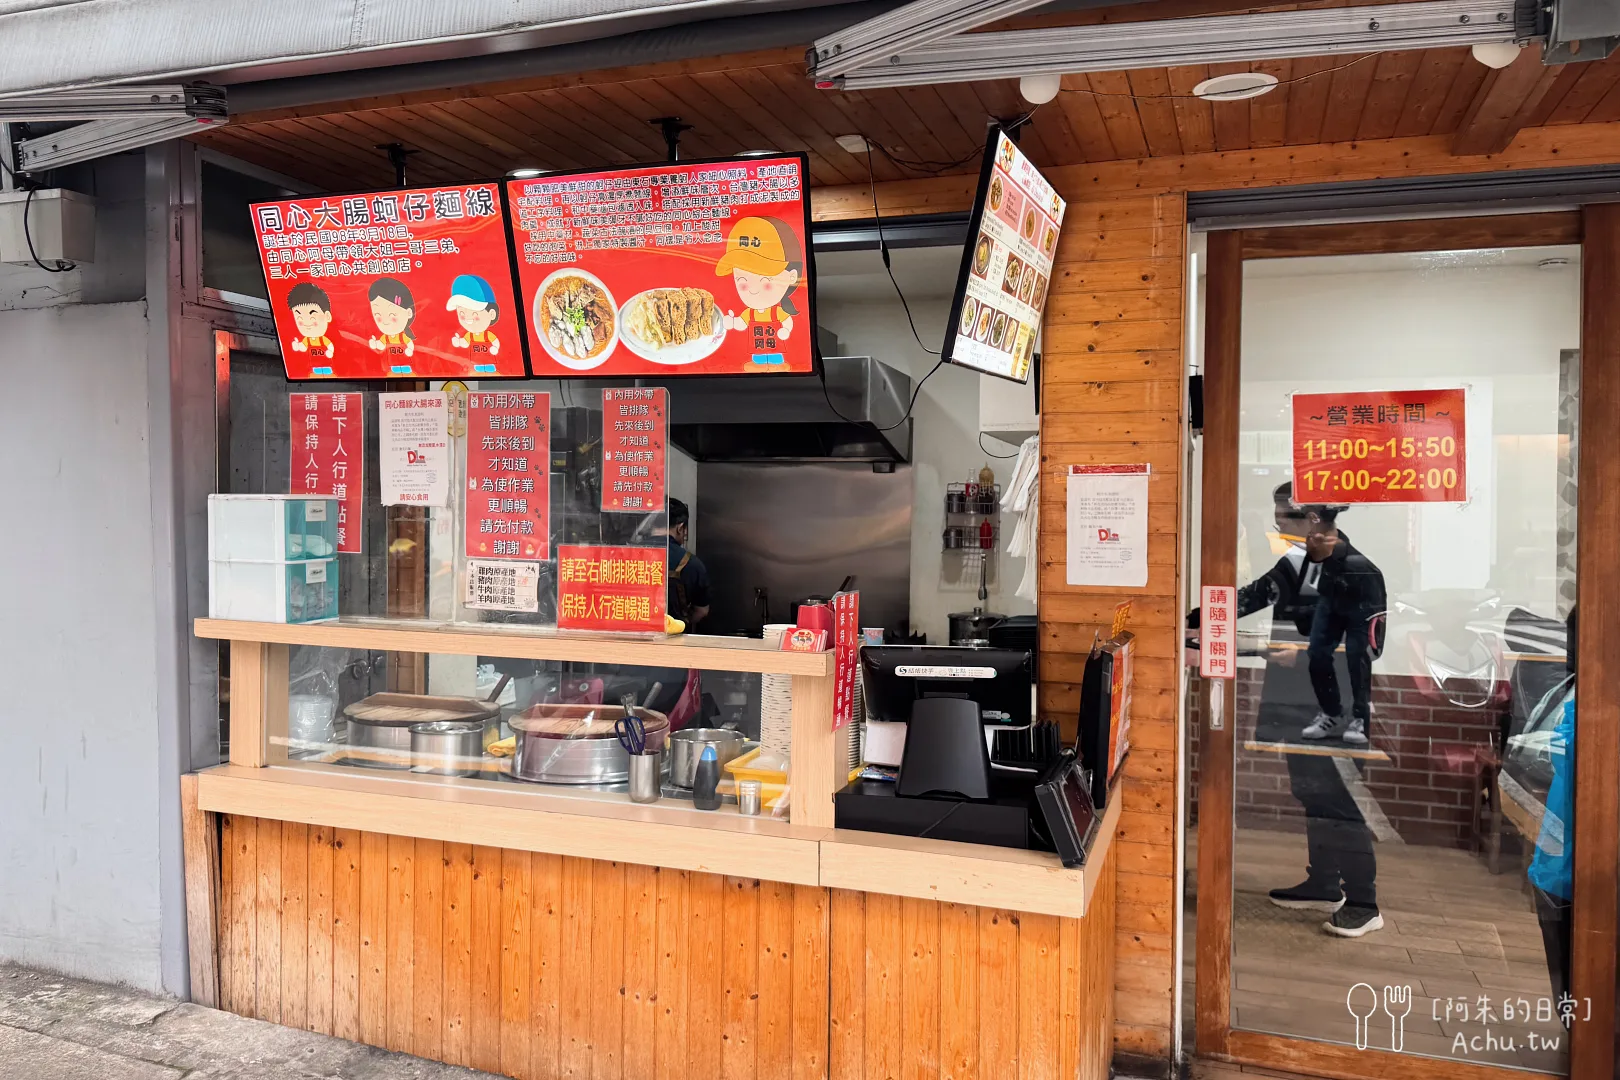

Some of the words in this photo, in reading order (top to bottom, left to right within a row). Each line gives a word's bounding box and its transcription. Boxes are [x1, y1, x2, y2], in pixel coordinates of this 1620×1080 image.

[258, 188, 496, 234] 同心大腸蚵仔麵線
[739, 235, 761, 248] 同心
[270, 260, 423, 278] 三人一家同心共創的店。
[754, 326, 776, 338] 同心
[473, 344, 488, 353] 同心
[482, 394, 534, 408] 內用外帶
[614, 389, 654, 400] 內用外帶
[619, 404, 648, 416] 皆排隊
[489, 415, 528, 430] 皆排隊
[614, 420, 654, 431] 先來後到
[305, 394, 318, 495] 請保持人行
[482, 436, 534, 451] 先來後到
[619, 435, 648, 446] 才知道
[1303, 436, 1456, 460] 11:00~15:50
[614, 450, 654, 462] 為使作業
[488, 457, 528, 472] 才知道
[618, 466, 648, 477] 更順暢
[482, 478, 534, 492] 為使作業
[614, 481, 652, 492] 請先付款
[1303, 468, 1457, 491] 17:00~22:00
[488, 498, 528, 514] 更順暢
[623, 496, 642, 508] 謝謝
[480, 519, 534, 534] 請先付款
[493, 540, 520, 555] 謝謝
[478, 566, 516, 577] 雞肉原產地
[562, 557, 662, 586] 請至右側排隊點餐
[478, 576, 516, 586] 豬肉原產地
[478, 586, 516, 596] 牛肉原產地
[478, 594, 516, 604] 羊肉原產地
[561, 595, 658, 621] 保持人行道暢通。
[1210, 589, 1227, 674] 請隨手關門
